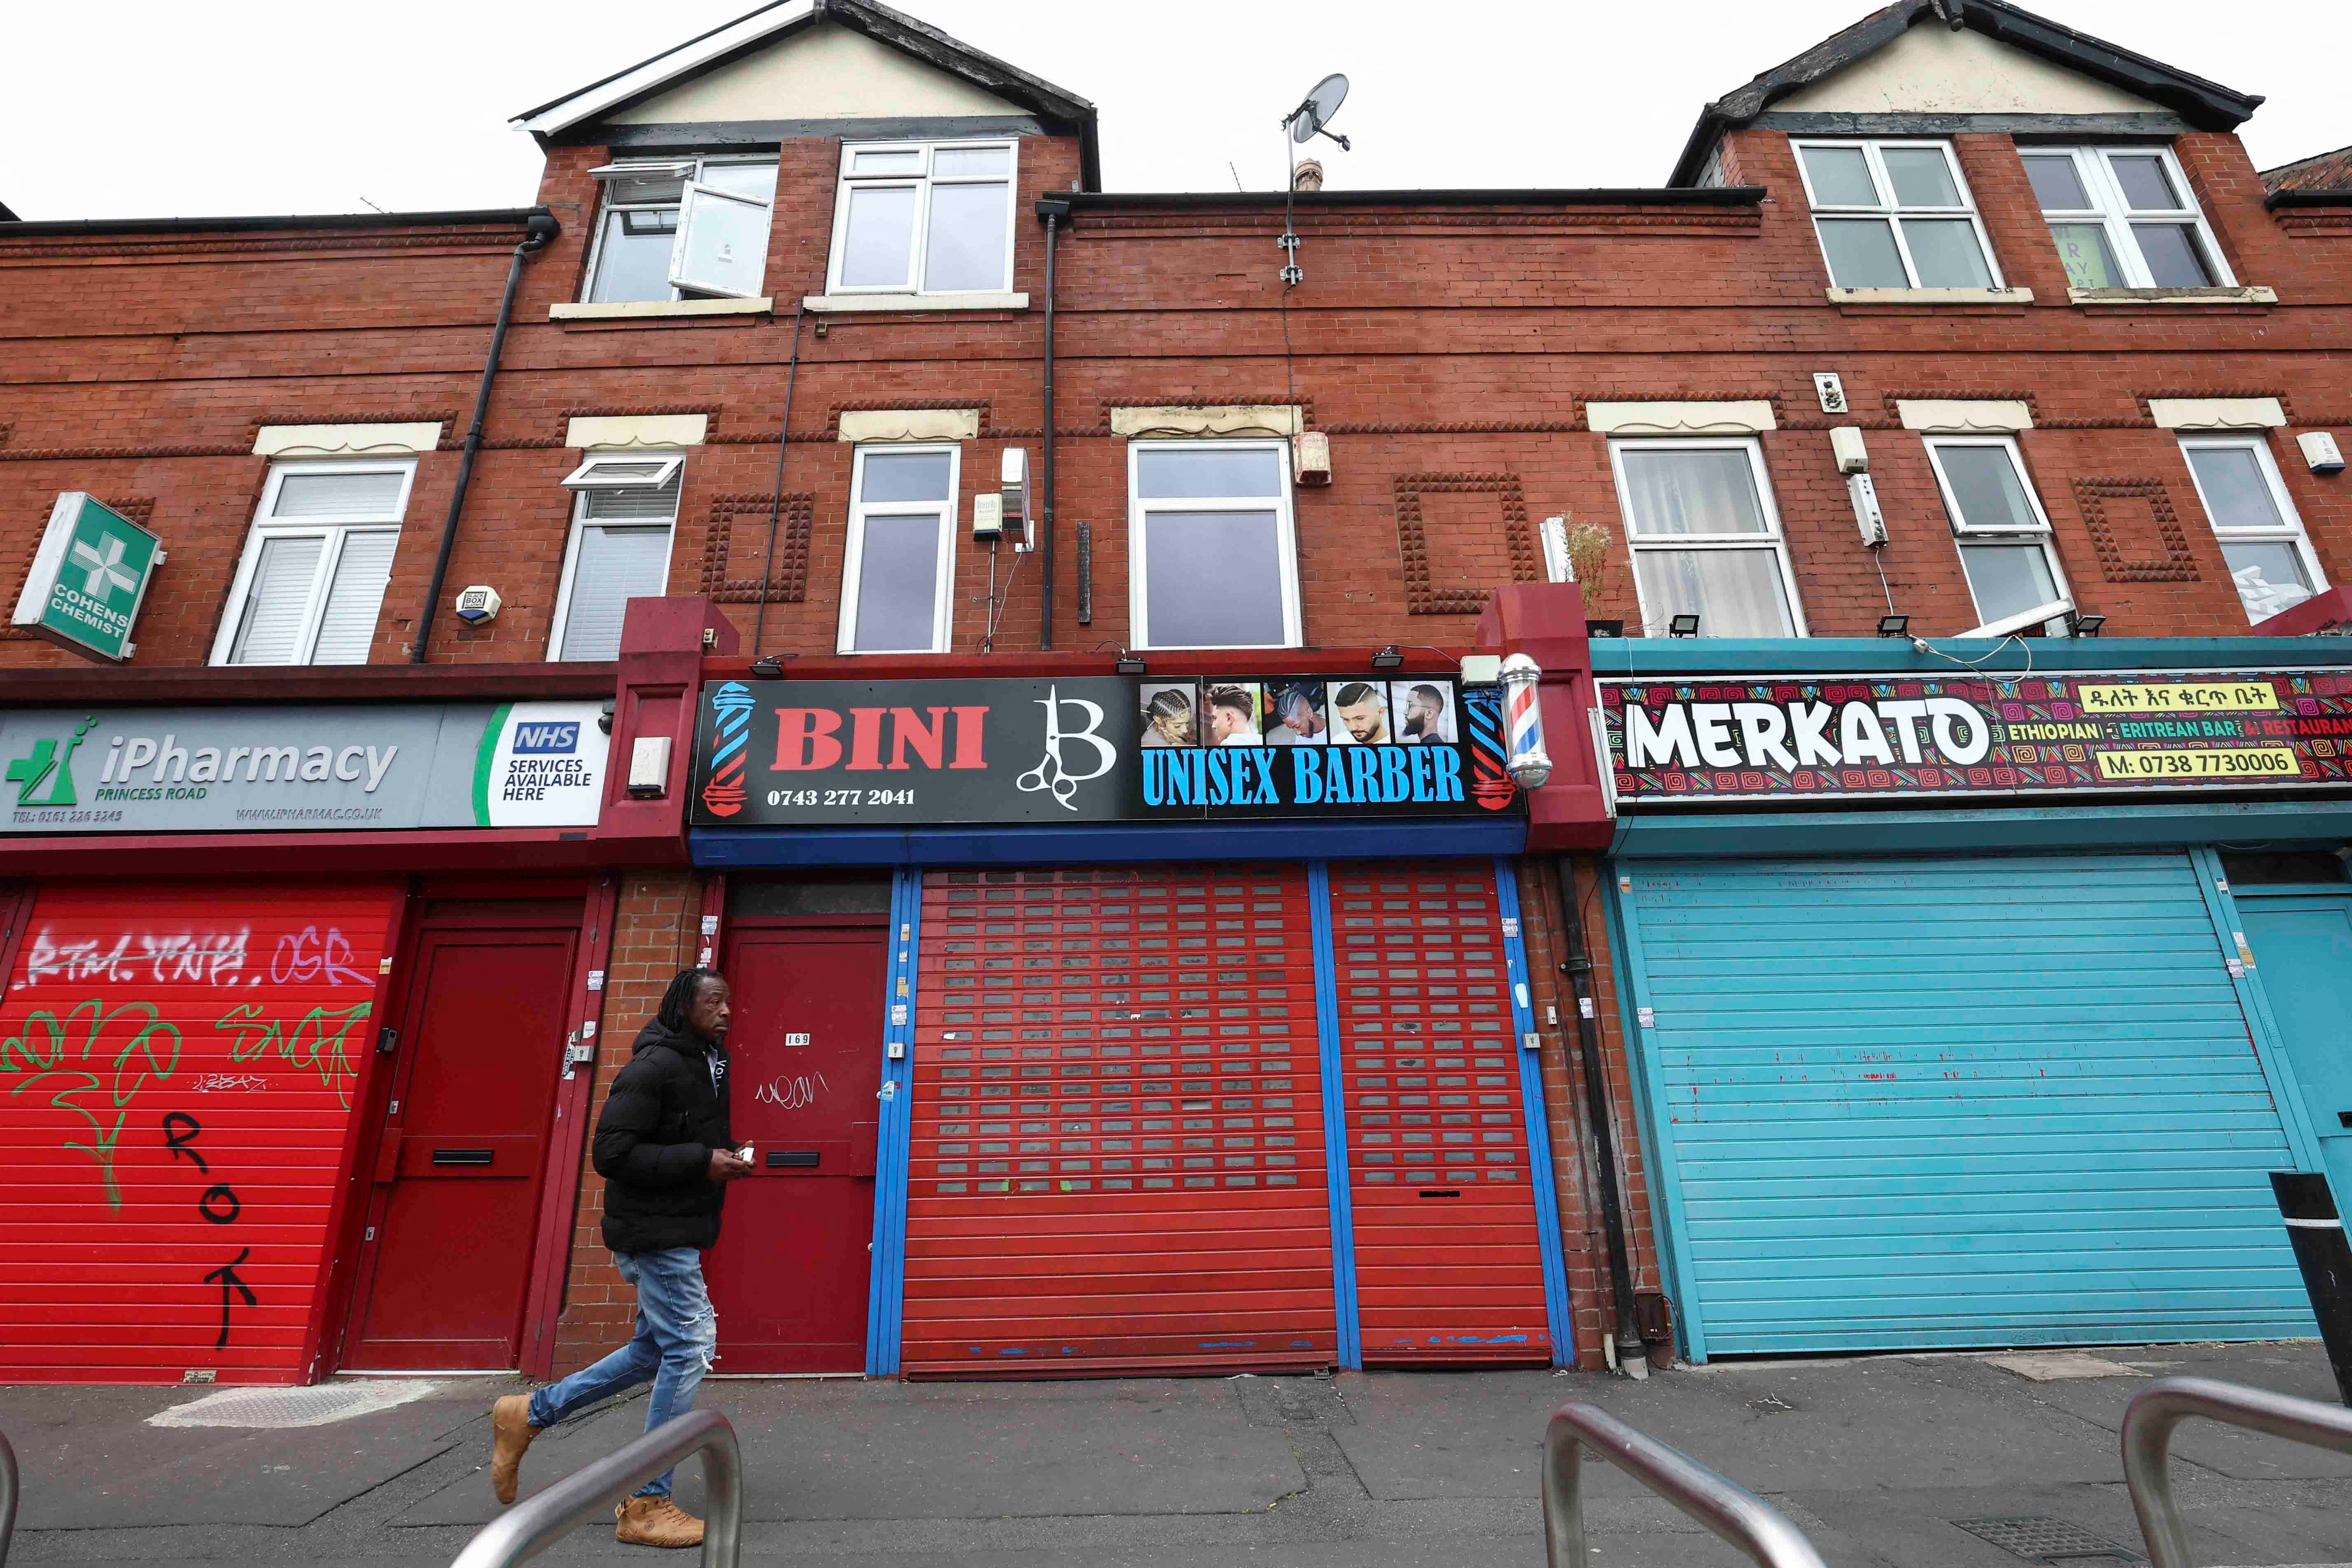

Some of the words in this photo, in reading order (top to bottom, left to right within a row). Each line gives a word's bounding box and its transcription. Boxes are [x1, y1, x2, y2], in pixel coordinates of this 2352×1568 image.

[54, 583, 128, 627] COHENS
[51, 598, 124, 638] CHEMIST
[515, 726, 576, 748] NHS
[770, 706, 989, 771] BINI
[1625, 698, 1990, 773] MERKATO
[2010, 723, 2099, 740] ETHIOPIAN
[2120, 721, 2199, 738] ERITREAN
[2204, 720, 2237, 736] BAR
[100, 735, 399, 792] iPharmacy
[508, 759, 583, 773] SERVICES
[2107, 756, 2135, 774] M:
[2140, 755, 2192, 773] 0738
[2195, 753, 2289, 771] 7730006
[504, 773, 592, 787] AVAILABLE
[1141, 748, 1280, 805] UNISEX
[1291, 746, 1465, 804] BARBER
[95, 788, 162, 801] PRINCESS
[166, 788, 207, 800] ROAD
[503, 788, 545, 801] HERE
[767, 789, 818, 806] 0743
[824, 789, 861, 806] 277
[868, 789, 915, 805] 2041
[13, 811, 36, 824] TEL:
[39, 811, 66, 823] 0161
[69, 810, 92, 823] 226
[786, 1035, 809, 1044] 169
